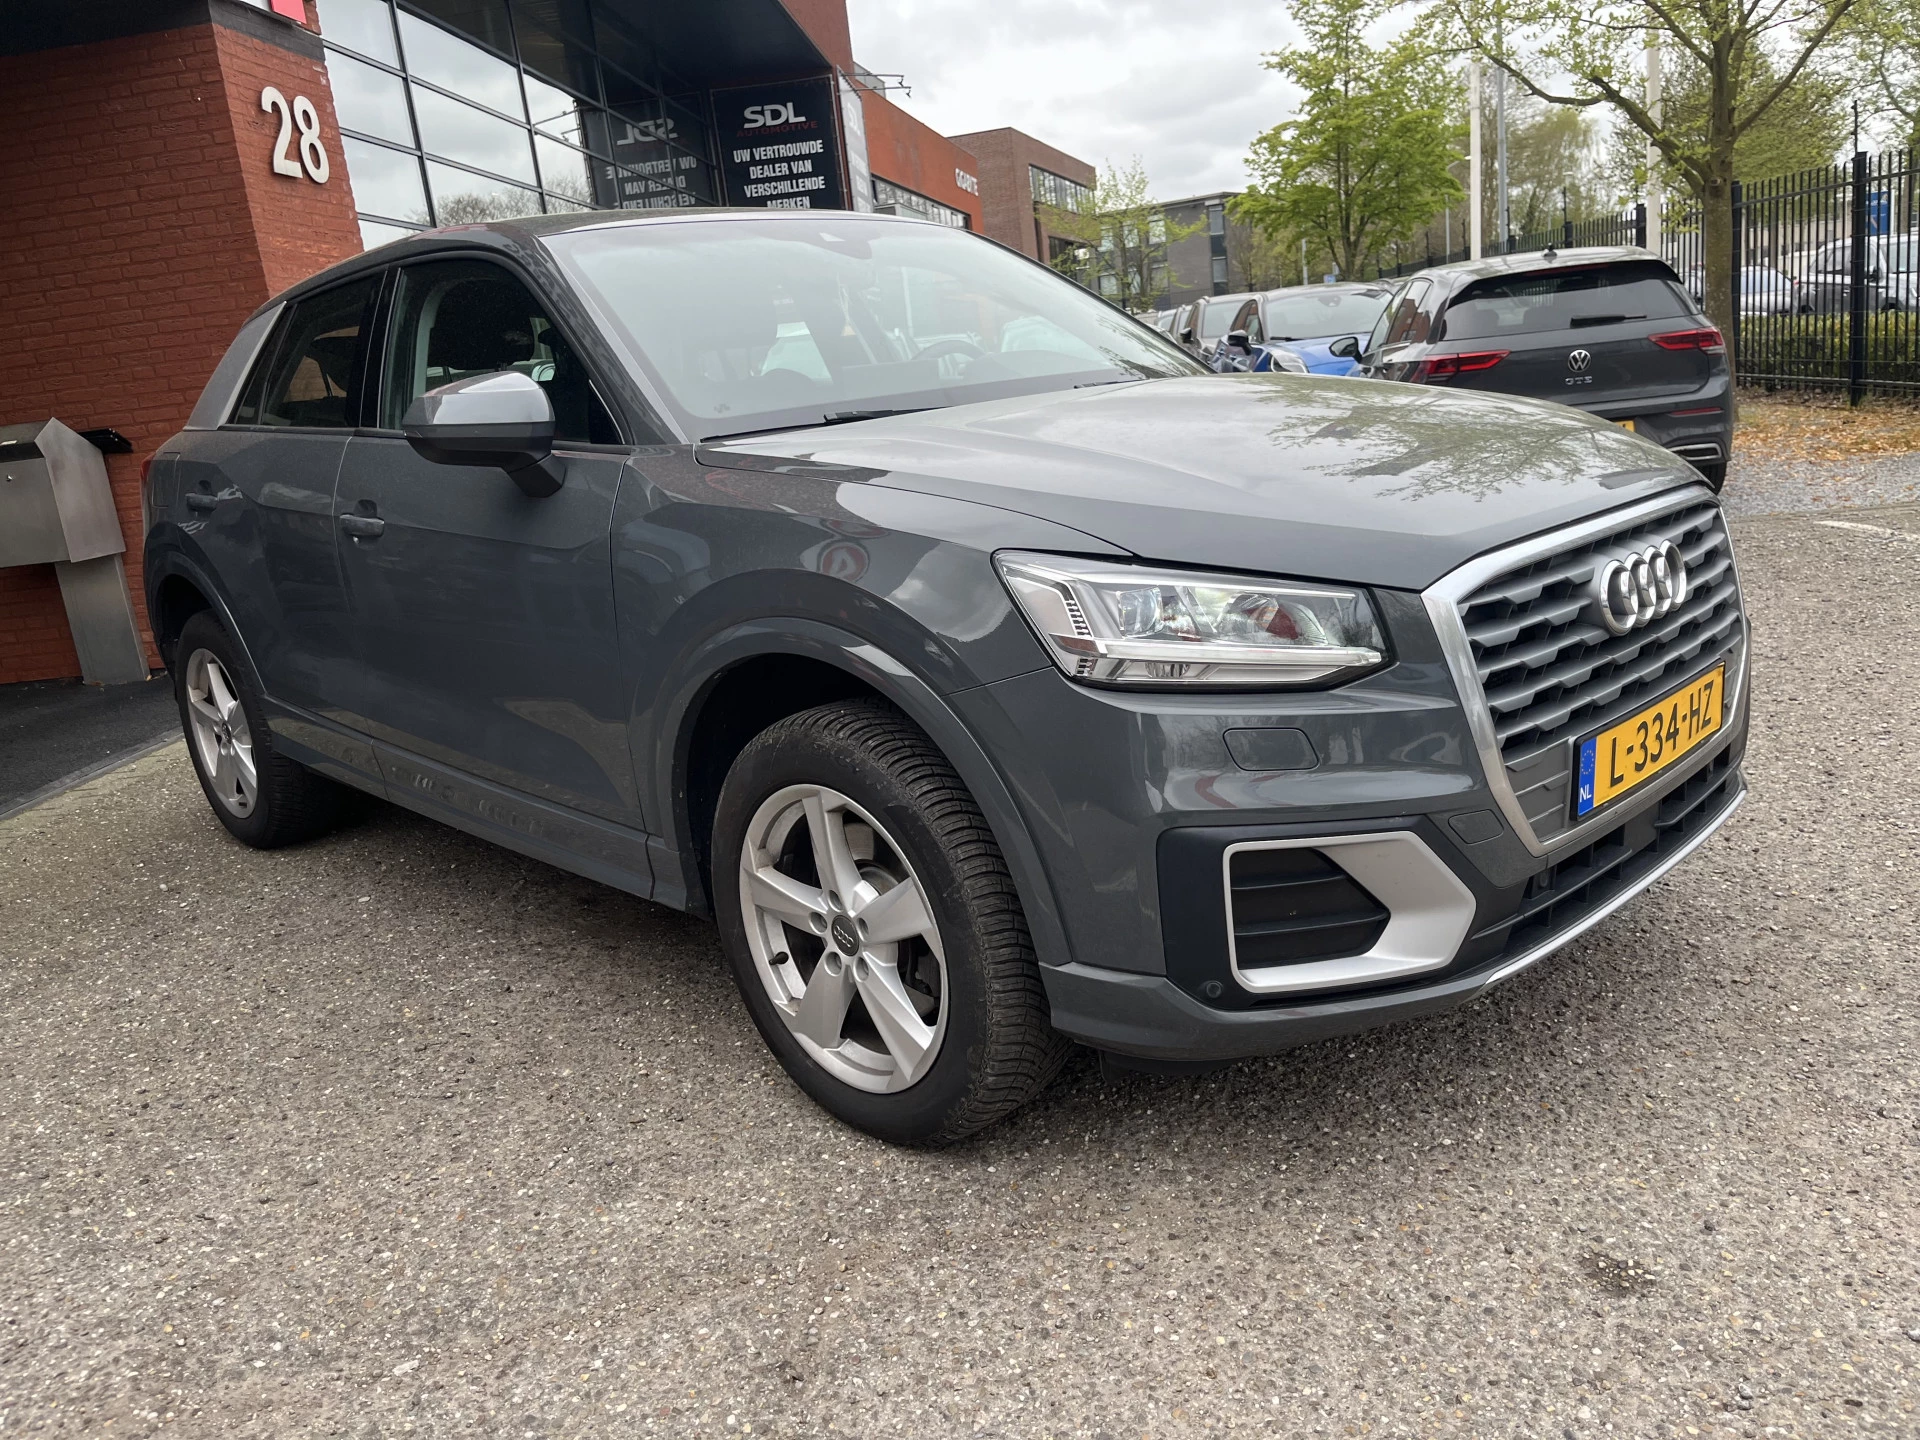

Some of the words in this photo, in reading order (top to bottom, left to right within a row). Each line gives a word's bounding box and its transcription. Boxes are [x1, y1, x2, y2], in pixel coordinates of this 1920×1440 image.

[743, 102, 806, 128] SDL
[261, 86, 330, 184] 28
[736, 120, 818, 137] AUTOMOTIVE
[733, 149, 751, 163] UW
[752, 139, 824, 161] VERTROUWDE
[749, 162, 789, 180] DEALER
[790, 159, 813, 174] VAN
[744, 176, 825, 197] VERSCHILLENDE
[1609, 679, 1715, 788] L-334-HZ
[1579, 784, 1592, 803] NL
